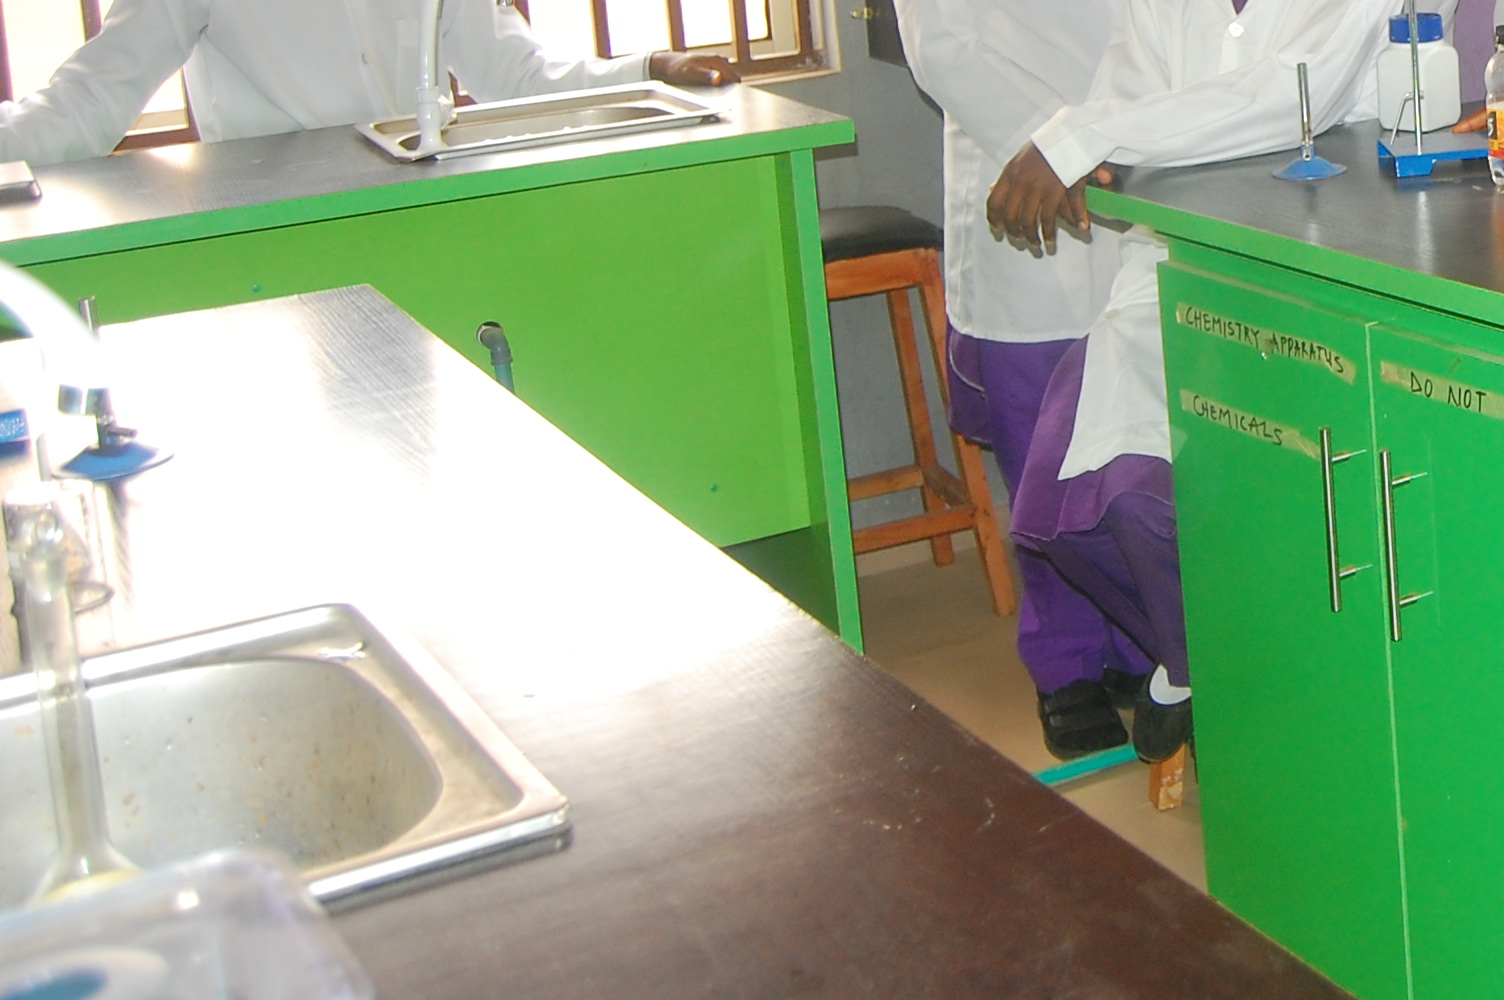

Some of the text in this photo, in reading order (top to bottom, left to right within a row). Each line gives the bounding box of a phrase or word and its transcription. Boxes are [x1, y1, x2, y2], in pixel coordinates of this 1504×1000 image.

[1185, 306, 1344, 374] CHEMISTRY APPARATUS
[1410, 371, 1433, 398] DO
[1447, 385, 1487, 413] NOT
[1193, 394, 1283, 446] CHEMICALS
